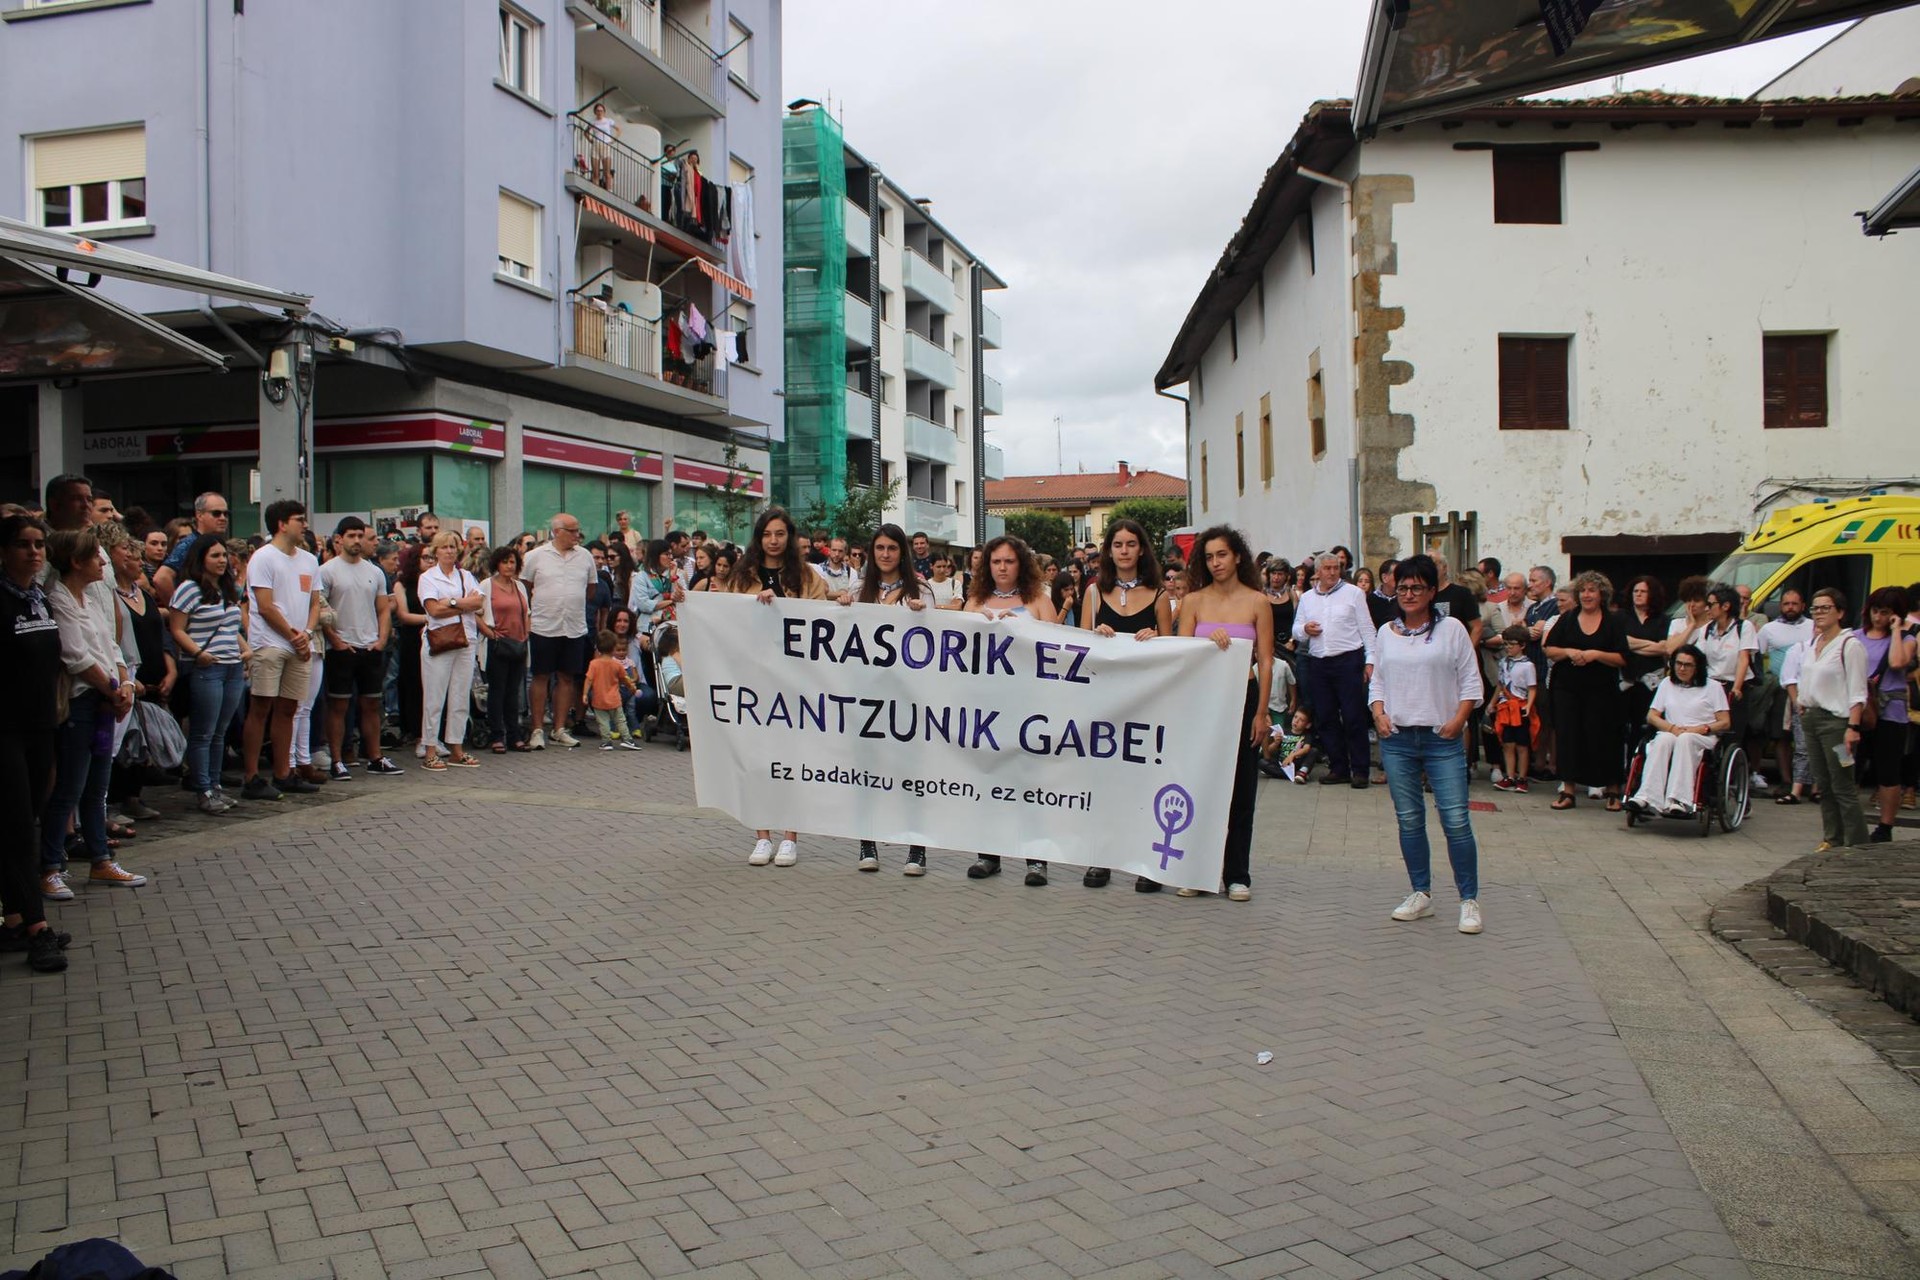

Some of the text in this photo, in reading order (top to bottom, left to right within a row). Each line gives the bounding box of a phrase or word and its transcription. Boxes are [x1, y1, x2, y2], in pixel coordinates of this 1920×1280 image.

[84, 436, 141, 450] LABORAL
[459, 427, 484, 439] LABORAL
[783, 617, 1091, 684] ERASORIK EZ
[709, 684, 1165, 764] ERANTZUNIK GABE!
[770, 762, 1092, 811] Ez badakizu egoten, ez etorri!
